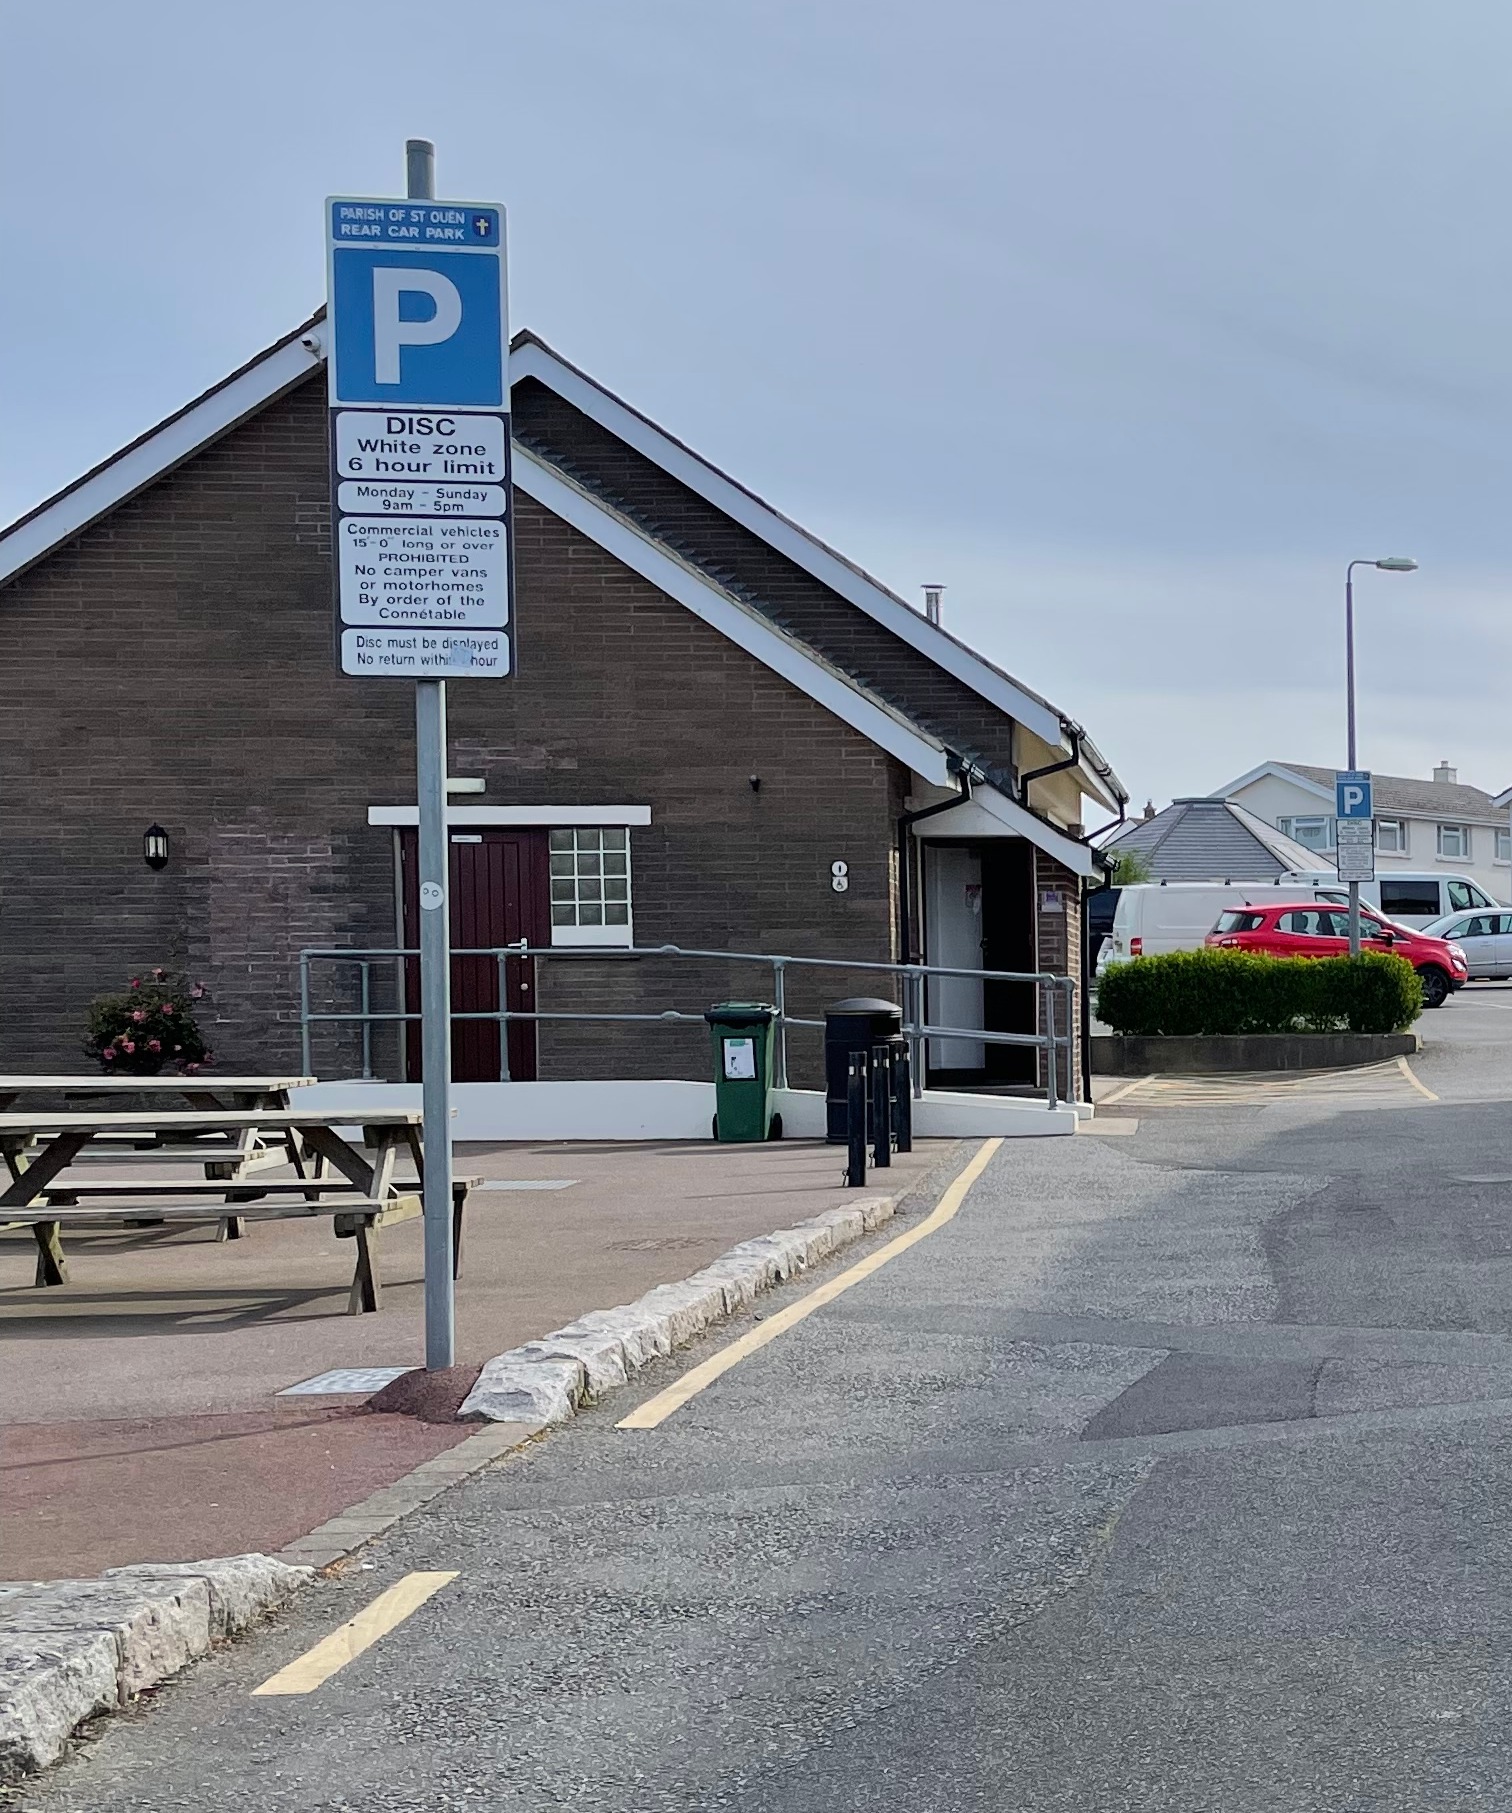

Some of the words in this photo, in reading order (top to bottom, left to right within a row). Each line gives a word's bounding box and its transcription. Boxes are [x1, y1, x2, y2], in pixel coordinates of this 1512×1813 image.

[340, 207, 384, 220] PARISH
[389, 209, 405, 221] OF
[410, 210, 426, 222] ST
[341, 224, 380, 236] REAR
[388, 226, 419, 237] CAR
[426, 227, 464, 239] PARK
[372, 266, 462, 384] P
[387, 417, 456, 436] DISC
[357, 439, 421, 453] White
[433, 444, 486, 455] zone
[349, 457, 362, 471] 6
[376, 458, 432, 472] hour
[444, 460, 495, 474] limit
[357, 487, 414, 500] Monday
[436, 488, 487, 501] Sunday
[383, 500, 412, 510] 9am
[434, 501, 464, 512] 5pm
[348, 524, 433, 536] Commercial
[440, 526, 499, 537] vehicles
[402, 540, 433, 550] long
[379, 553, 469, 563] PROHIBITED
[355, 565, 376, 575] No
[384, 567, 444, 579] camper
[452, 569, 487, 578] vans
[384, 582, 483, 592] motorhomes
[359, 594, 378, 606] By
[387, 594, 428, 605] order
[437, 595, 451, 605] of
[460, 596, 484, 606] the
[356, 636, 382, 648] Disc
[388, 637, 416, 648] must
[423, 638, 436, 648] be
[358, 653, 373, 664] No
[379, 654, 415, 665] return
[470, 656, 498, 666] hour
[1344, 786, 1363, 814] P
